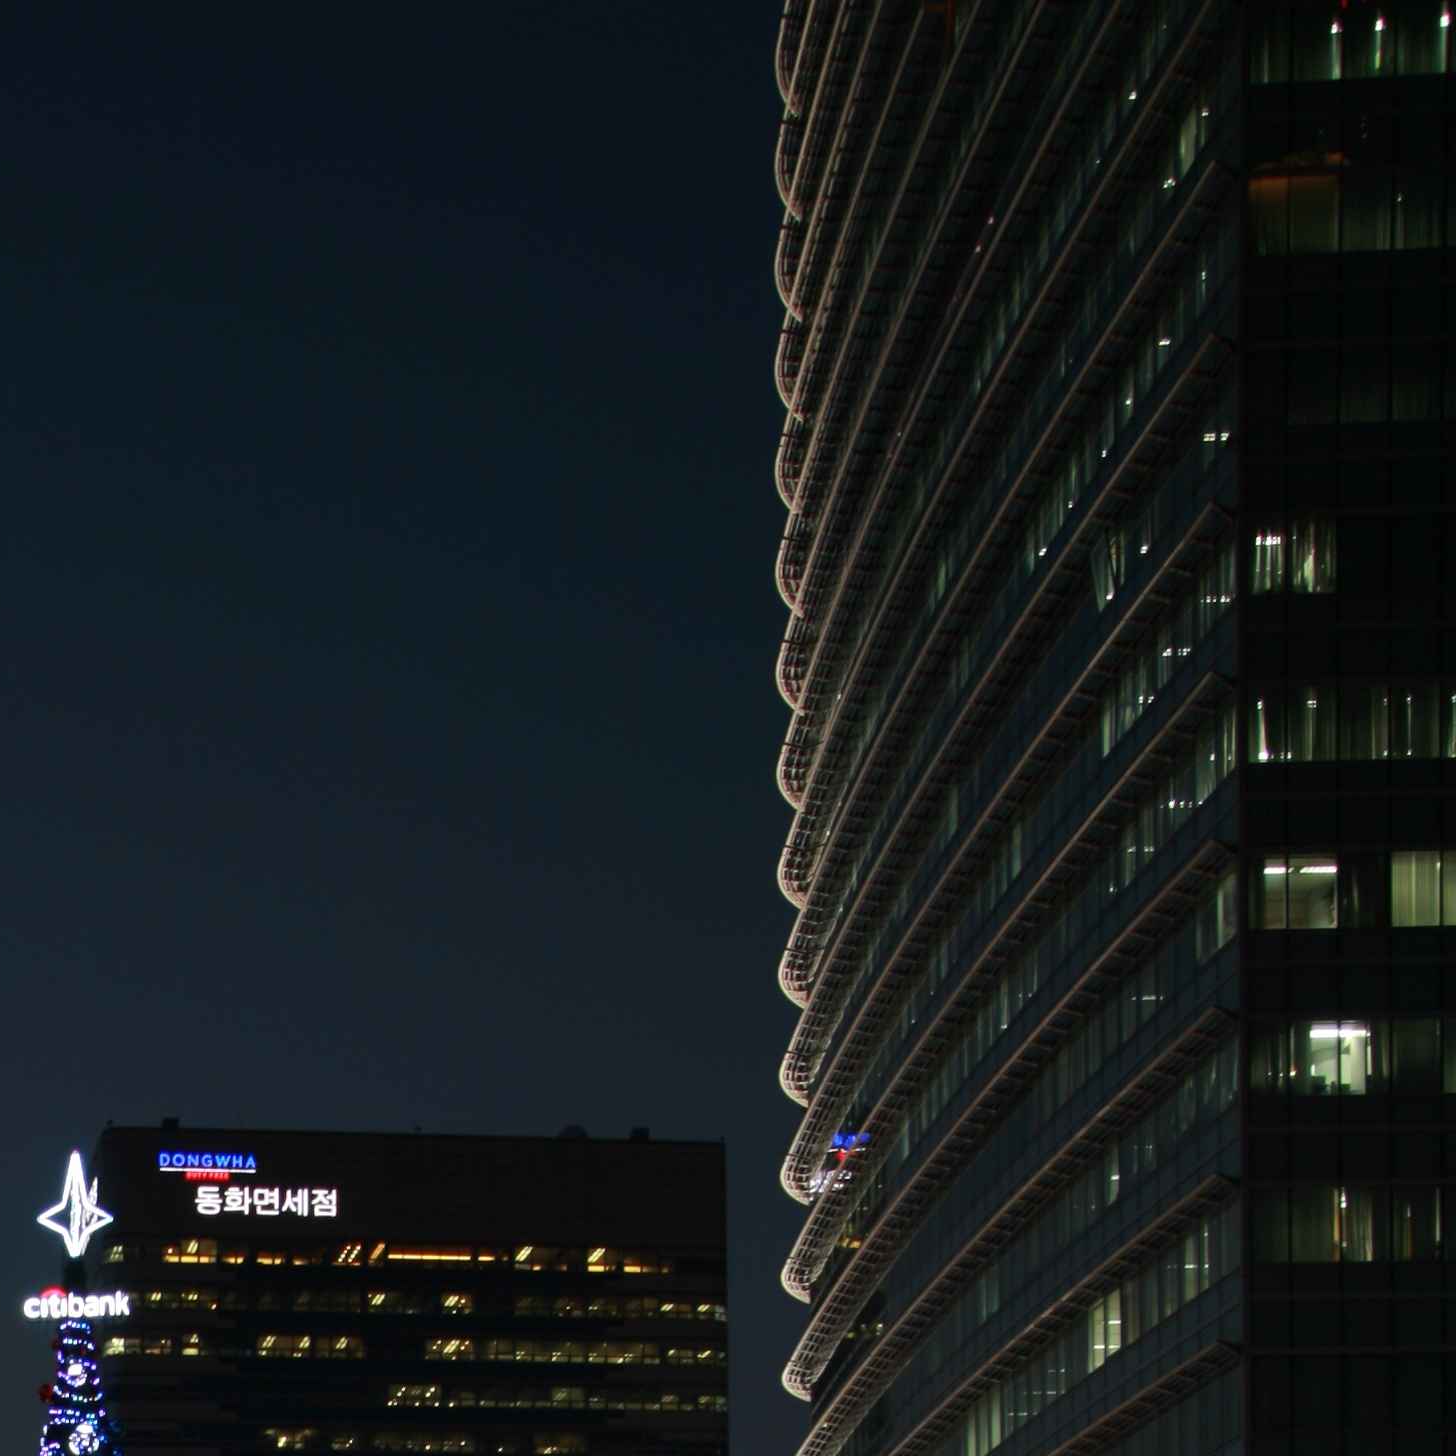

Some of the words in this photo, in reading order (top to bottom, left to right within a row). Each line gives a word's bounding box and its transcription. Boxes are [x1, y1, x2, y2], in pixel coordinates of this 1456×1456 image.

[159, 1153, 256, 1169] DONGWHA
[195, 1186, 337, 1218] 동화면세점
[23, 1289, 130, 1319] citibank
